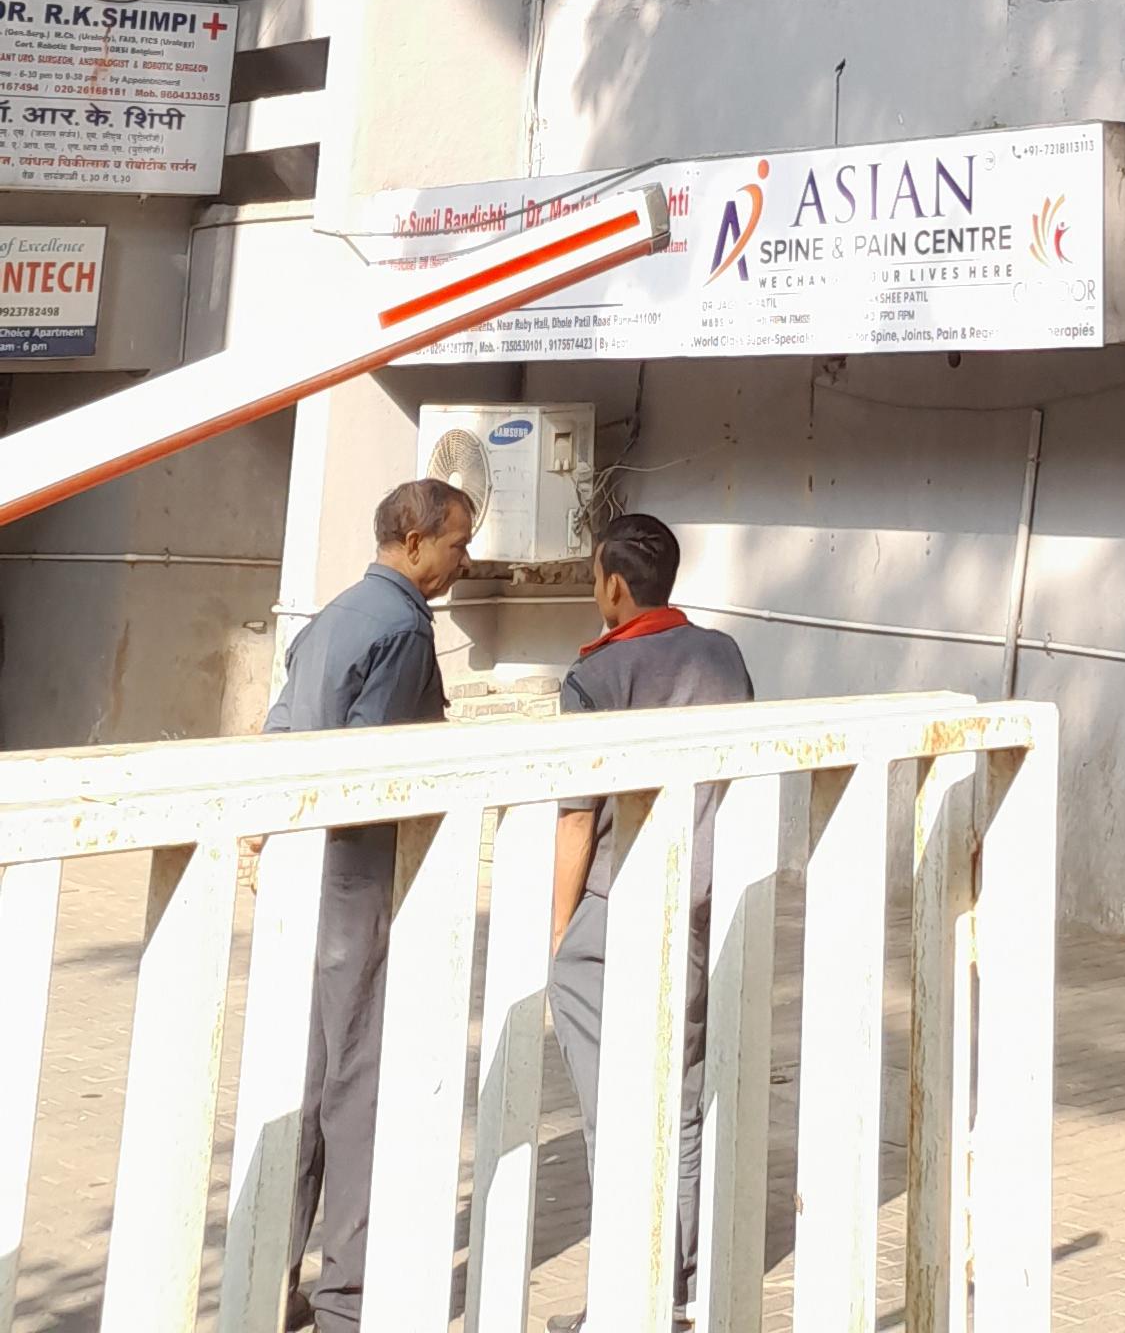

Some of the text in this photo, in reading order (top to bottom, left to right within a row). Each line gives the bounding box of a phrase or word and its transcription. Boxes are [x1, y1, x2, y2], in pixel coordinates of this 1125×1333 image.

[788, 153, 978, 228] ASIAN
[759, 224, 1013, 265] SPINE & PAIN CENTRE
[0, 261, 97, 294] NTECH
[758, 275, 778, 289] WE
[909, 266, 961, 282] LIVES
[968, 263, 1014, 279] HERE
